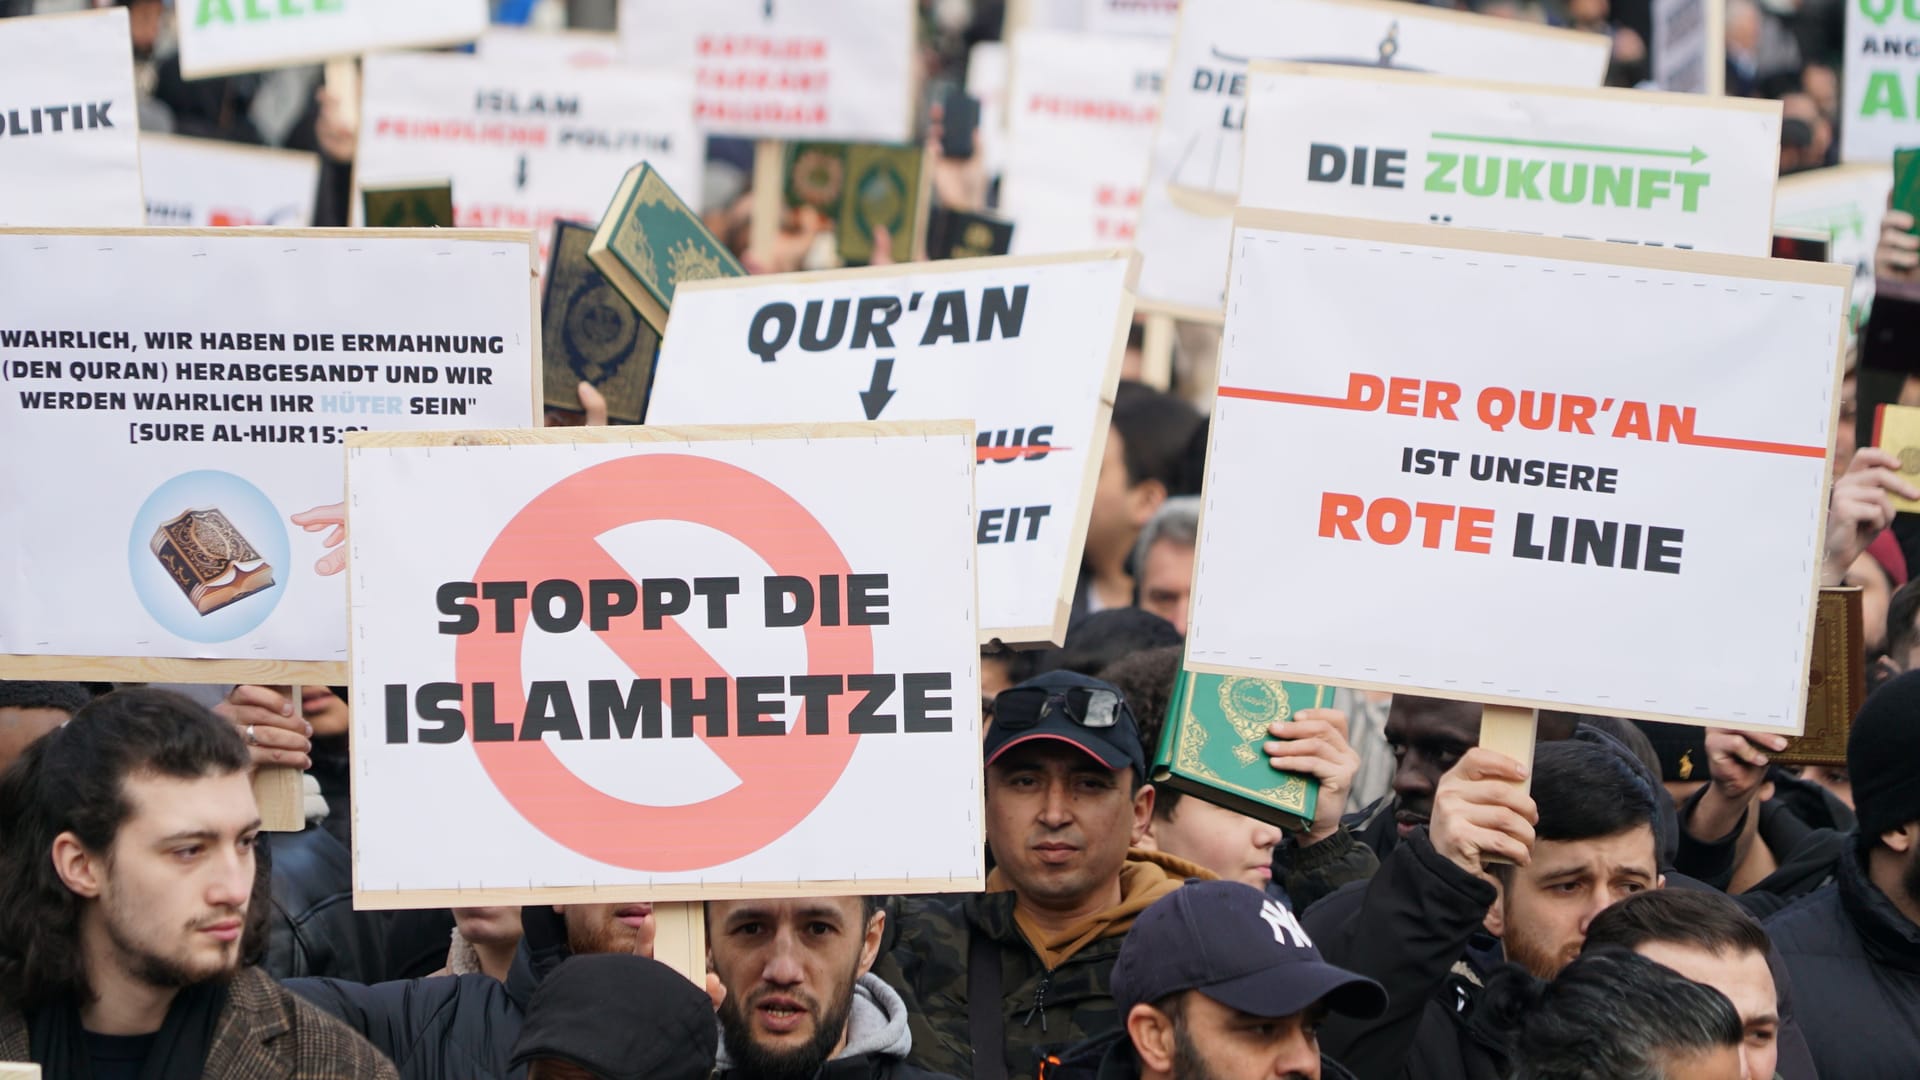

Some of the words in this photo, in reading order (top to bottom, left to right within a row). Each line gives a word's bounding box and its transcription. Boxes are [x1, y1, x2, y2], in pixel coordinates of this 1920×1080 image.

[474, 88, 580, 114] ISLAM
[1860, 72, 1920, 118] A
[0, 103, 113, 136] LITIK
[1308, 145, 1406, 188] DIE
[1424, 151, 1710, 212] ZUKUNFT
[0, 330, 137, 353] WAHRLICH,
[144, 331, 193, 350] WIR
[200, 332, 286, 352] HABEN
[293, 334, 335, 352] DIE
[342, 334, 504, 354] ERMAHNUNG
[748, 286, 1029, 362] QUR'AN
[3, 359, 62, 382] (DEN
[69, 361, 168, 383] QURAN)
[175, 362, 379, 383] HERABGESANDT
[386, 365, 439, 384] UND
[445, 366, 493, 385] WIR
[19, 391, 126, 410] WERDEN
[133, 392, 263, 412] WAHRLICH
[270, 394, 314, 413] IHR
[321, 390, 404, 414] HÜTER
[410, 396, 476, 416] SEIN"
[1345, 372, 1461, 421] DER
[1476, 386, 1697, 443] QUR'AN
[130, 422, 204, 445] [SURE
[1401, 447, 1460, 477] IST
[1470, 454, 1618, 494] UNSERE
[1317, 492, 1495, 555] ROTE
[1512, 512, 1684, 575] LINIE
[436, 576, 740, 635] STOPPT
[763, 573, 890, 628] DIE
[385, 672, 953, 744] ISLAMHETZE
